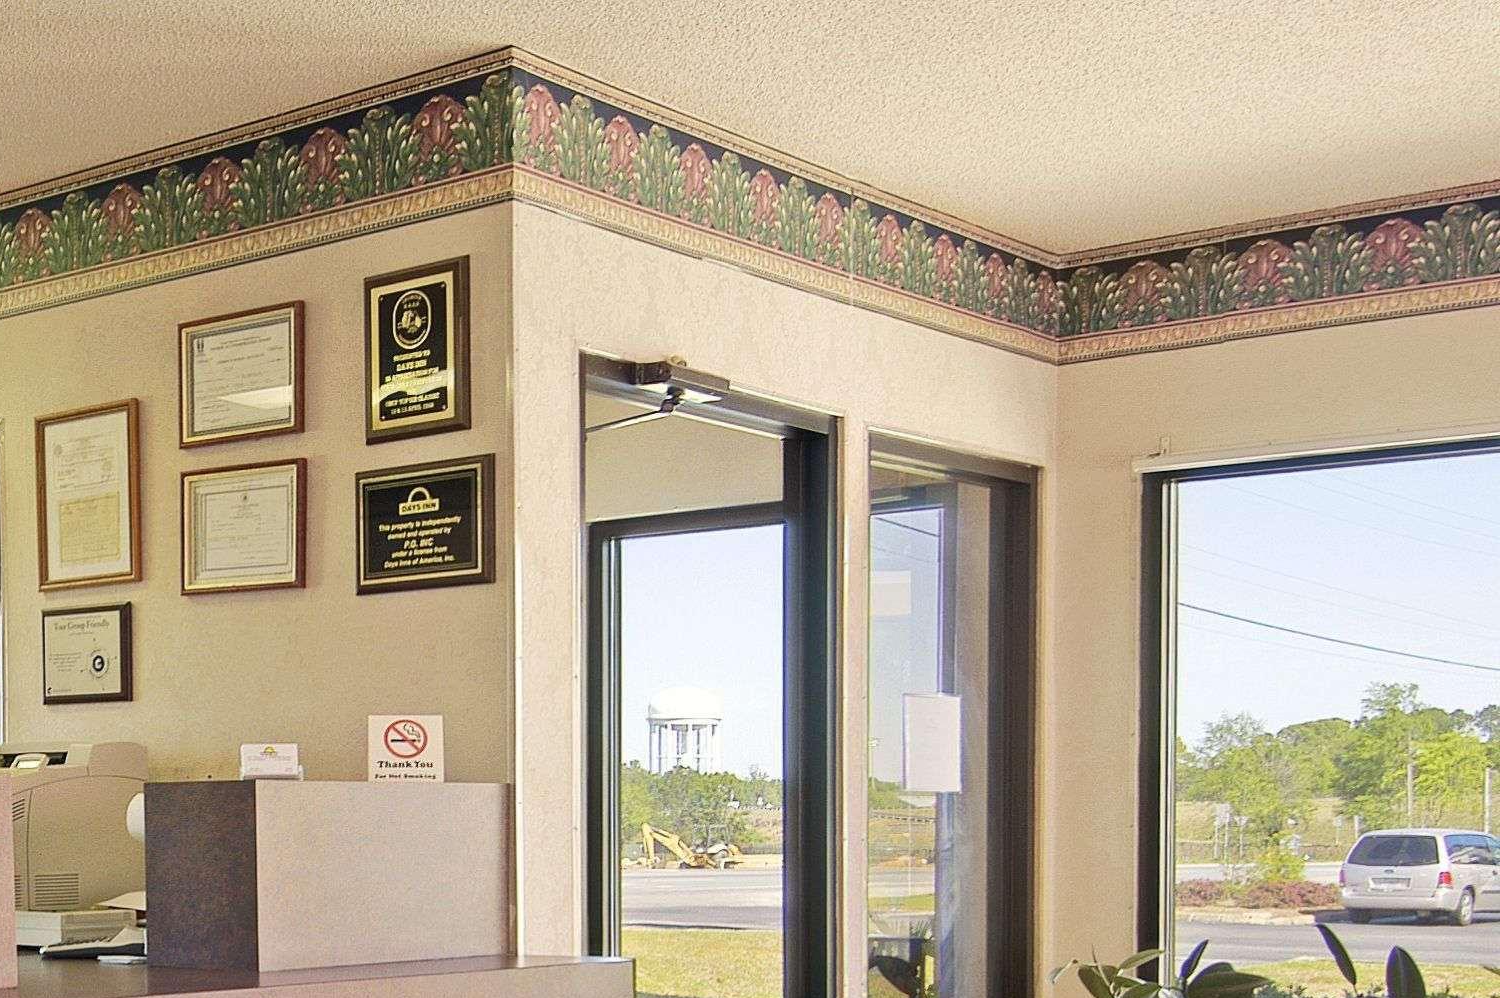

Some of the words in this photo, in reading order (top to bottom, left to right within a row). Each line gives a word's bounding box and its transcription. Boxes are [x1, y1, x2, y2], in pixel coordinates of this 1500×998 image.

[401, 504, 421, 513] DAYS
[422, 502, 436, 511] INN
[391, 521, 414, 532] property
[422, 516, 462, 527] independently
[387, 531, 406, 540] owned
[407, 530, 418, 538] and
[418, 527, 443, 537] operated
[443, 526, 452, 535] by
[391, 550, 408, 559] under
[384, 560, 398, 569] Days
[376, 760, 412, 769] Thank
[414, 760, 435, 769] You
